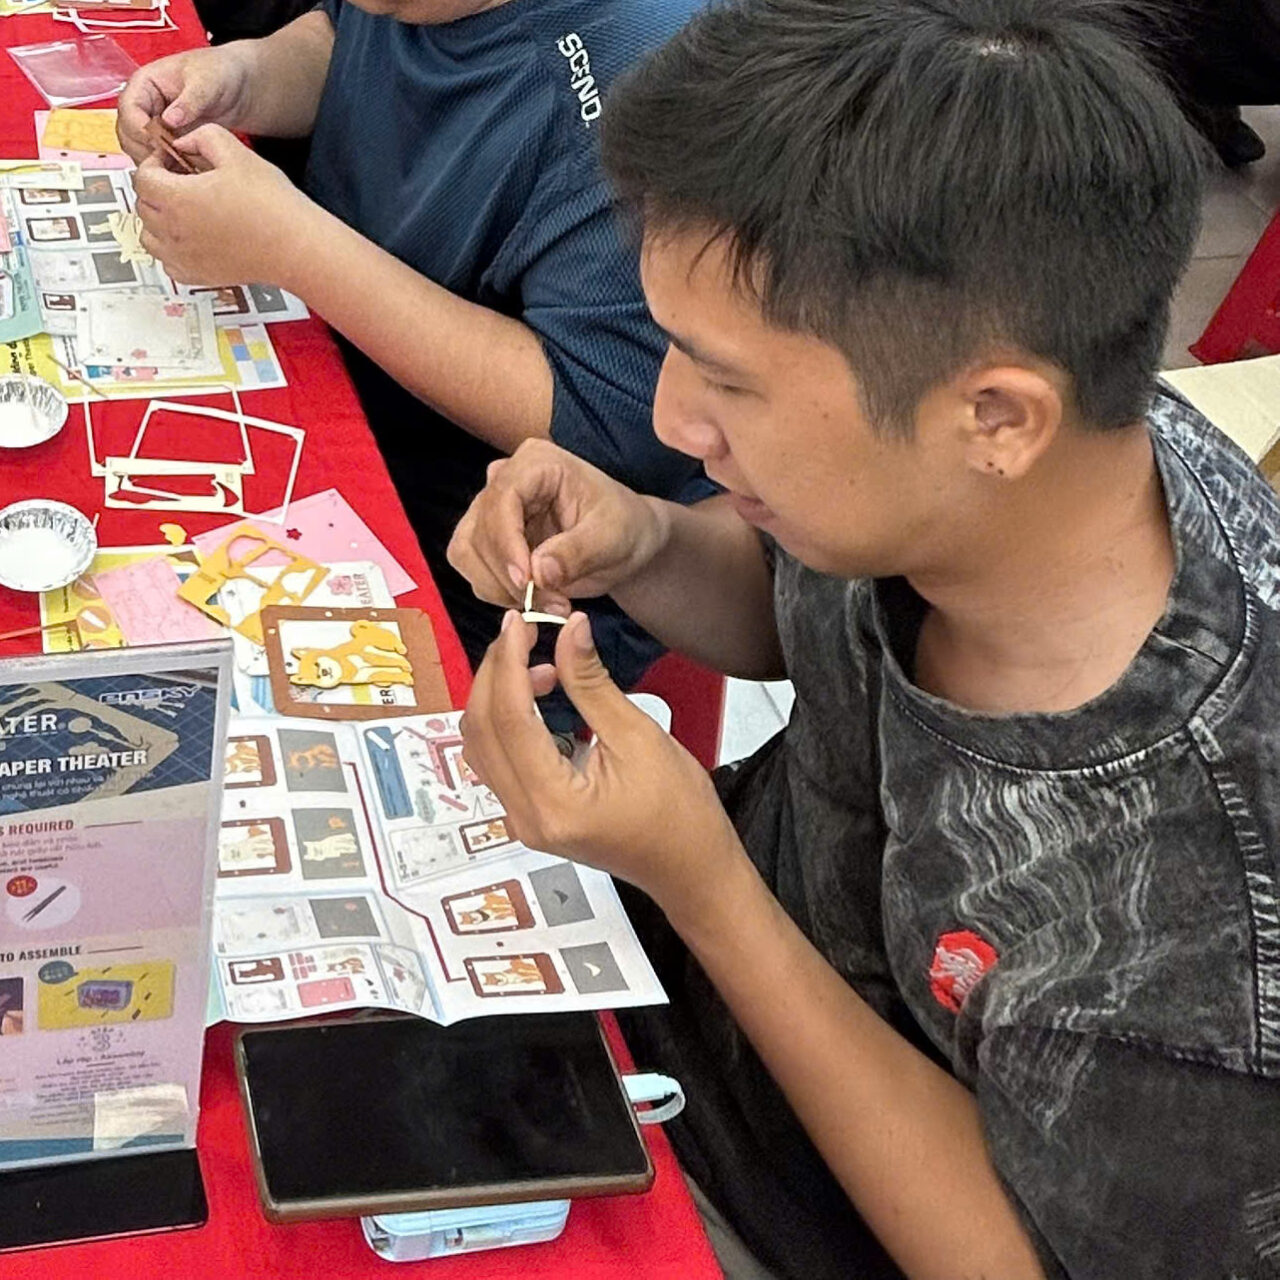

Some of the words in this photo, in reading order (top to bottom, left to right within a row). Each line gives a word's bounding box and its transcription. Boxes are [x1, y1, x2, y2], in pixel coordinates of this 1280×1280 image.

[353, 573, 371, 606] EATER
[57, 749, 148, 771] THEATER
[8, 820, 75, 837] REQUIRED
[0, 951, 16, 963] TO
[18, 945, 83, 962] ASSEMBLE
